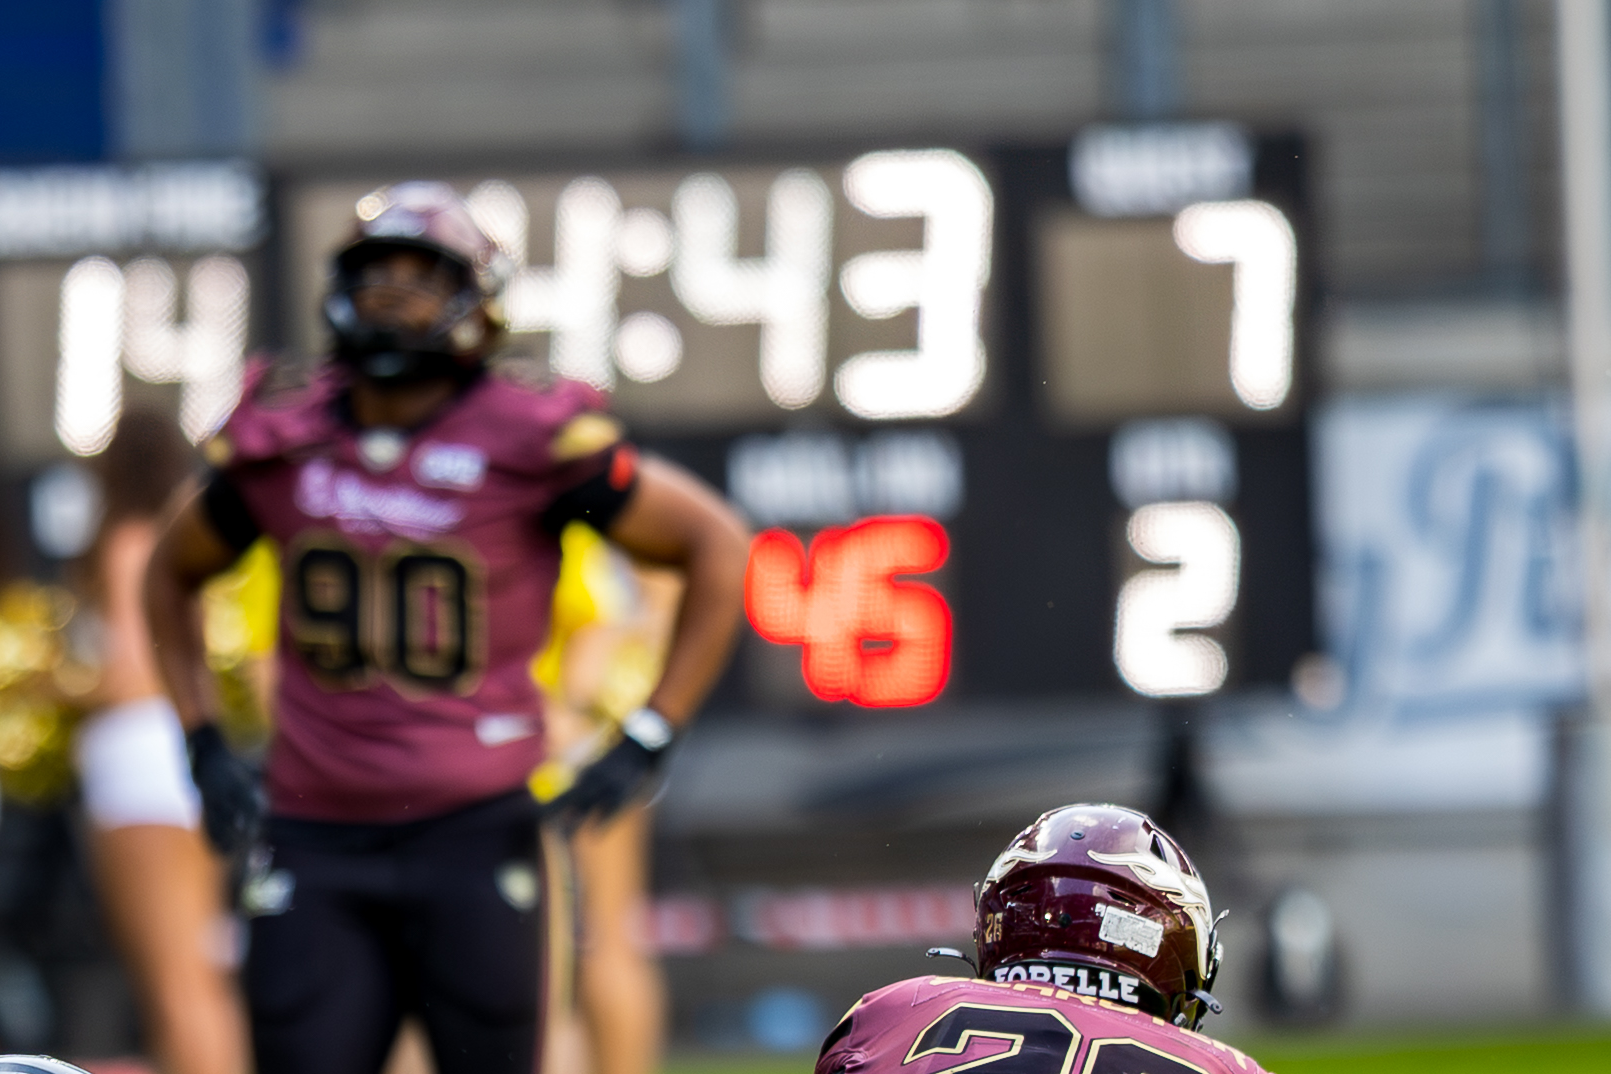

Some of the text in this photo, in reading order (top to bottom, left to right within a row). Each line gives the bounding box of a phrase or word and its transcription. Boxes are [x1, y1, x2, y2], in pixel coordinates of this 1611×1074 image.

[55, 255, 250, 456] 14
[1173, 199, 1296, 410] 7
[293, 543, 475, 690] 90
[1114, 501, 1241, 697] 2
[994, 965, 1139, 1004] FORELLE
